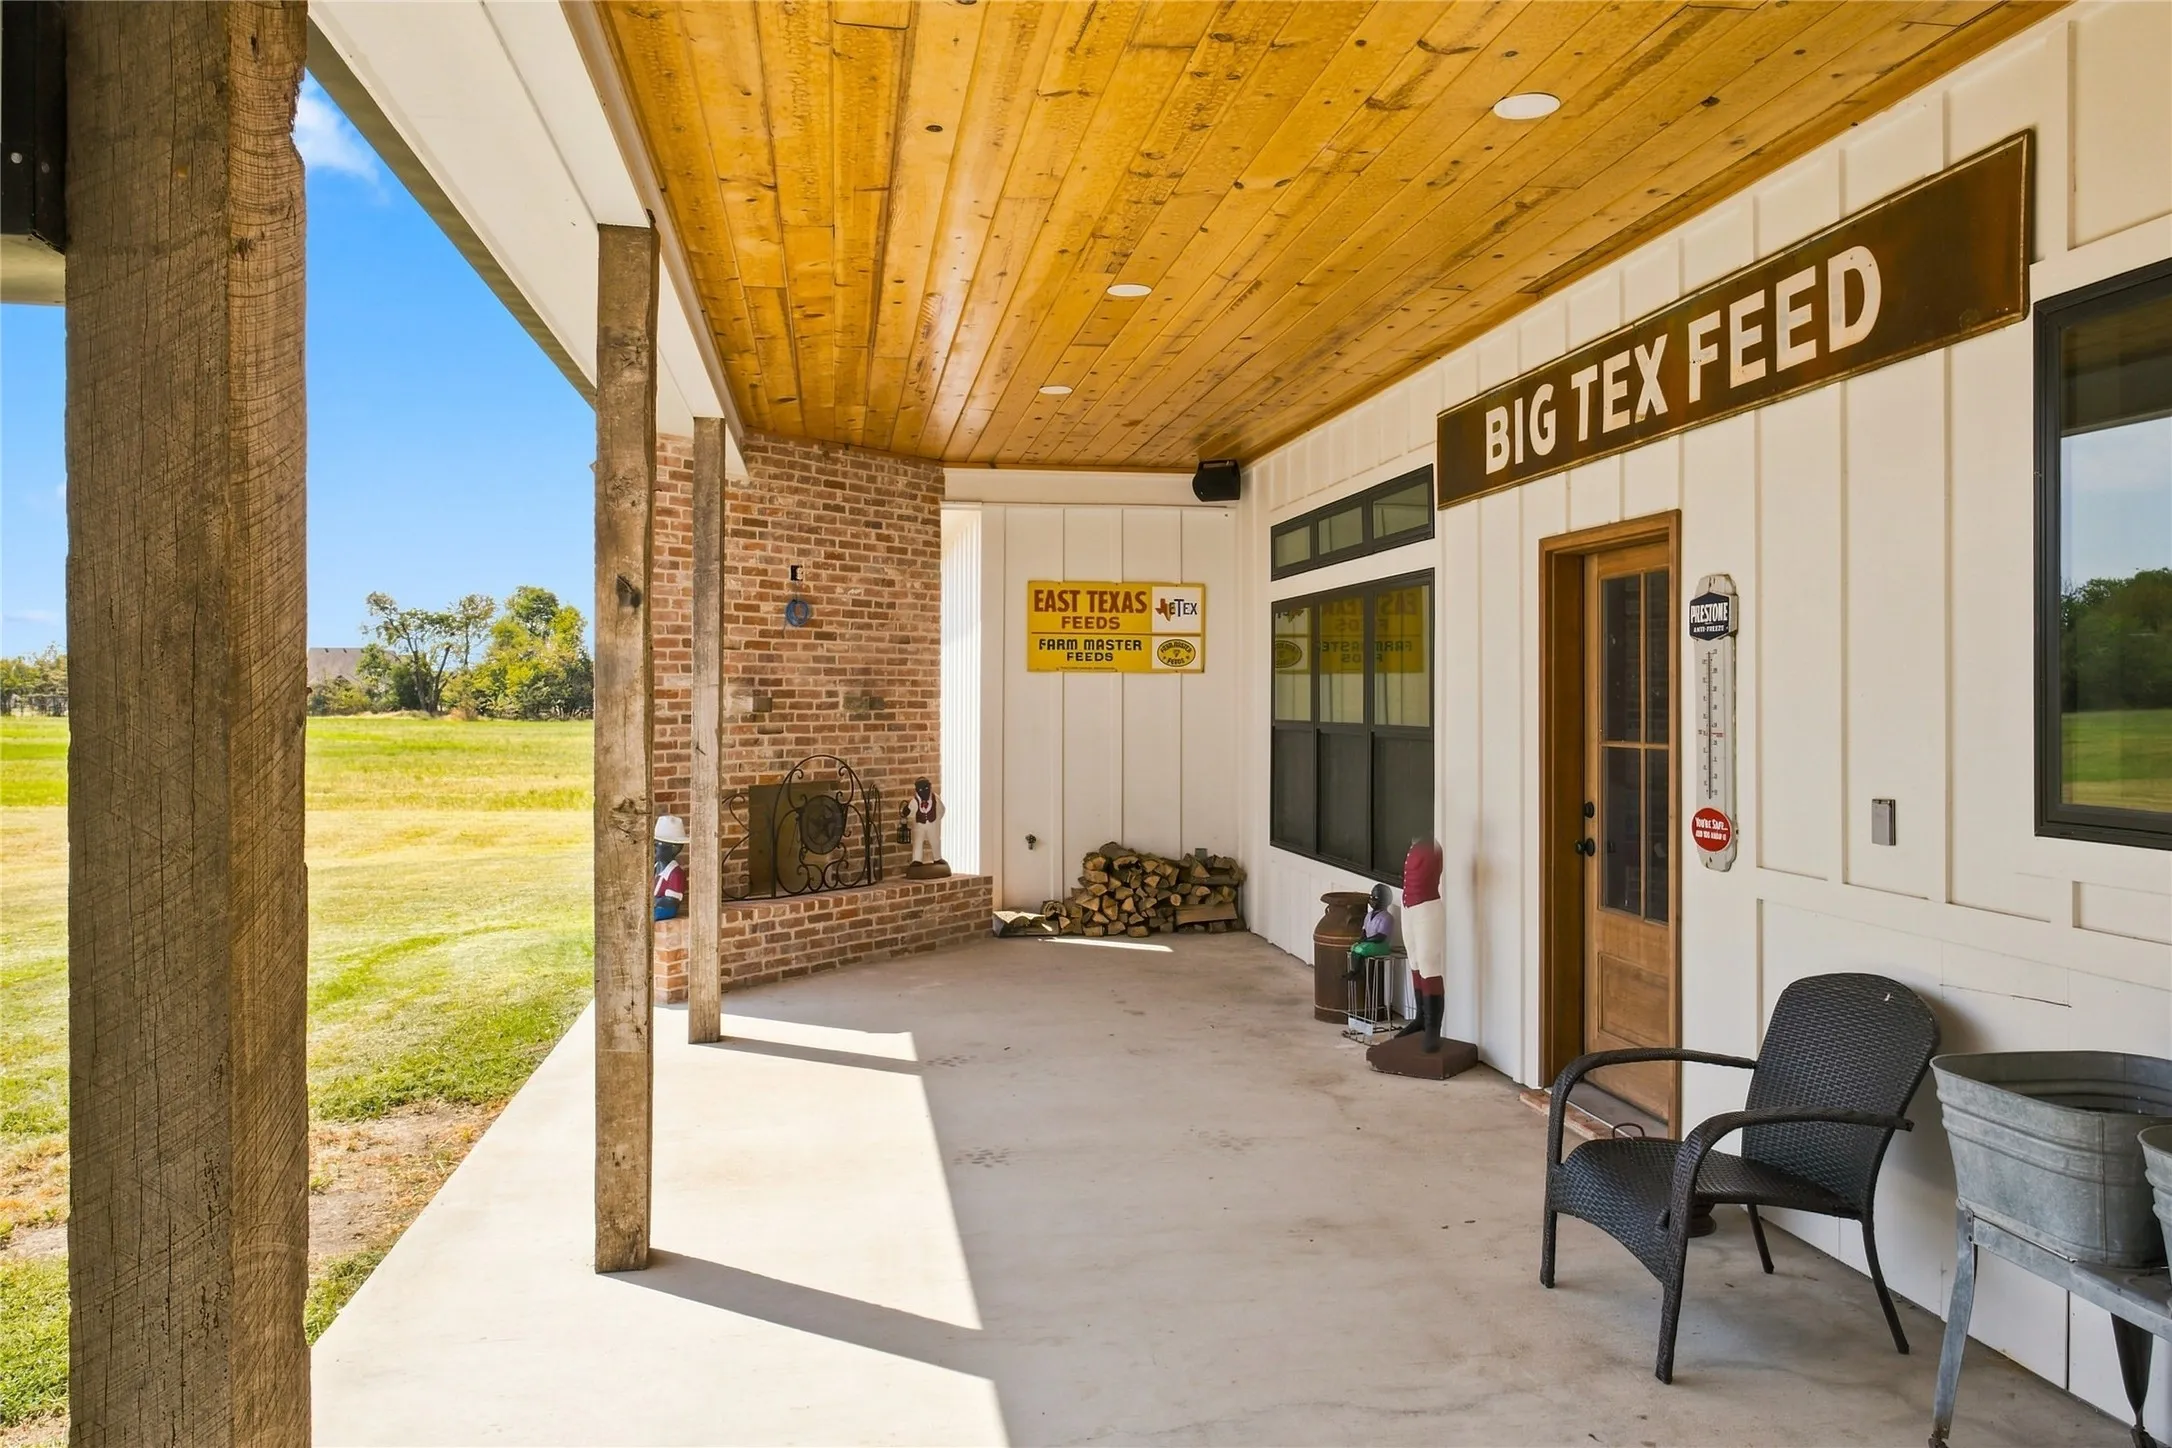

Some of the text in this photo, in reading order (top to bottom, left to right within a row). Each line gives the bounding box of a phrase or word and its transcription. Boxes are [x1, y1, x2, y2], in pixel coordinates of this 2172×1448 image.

[1485, 245, 1882, 475] BIG TEX FEED
[1034, 589, 1147, 613] EAST TEXAS
[1691, 602, 1728, 623] PRESTONE
[1062, 616, 1120, 629] FEEDS
[1039, 639, 1142, 651] FARM MASTER
[1067, 652, 1113, 661] FEEDS
